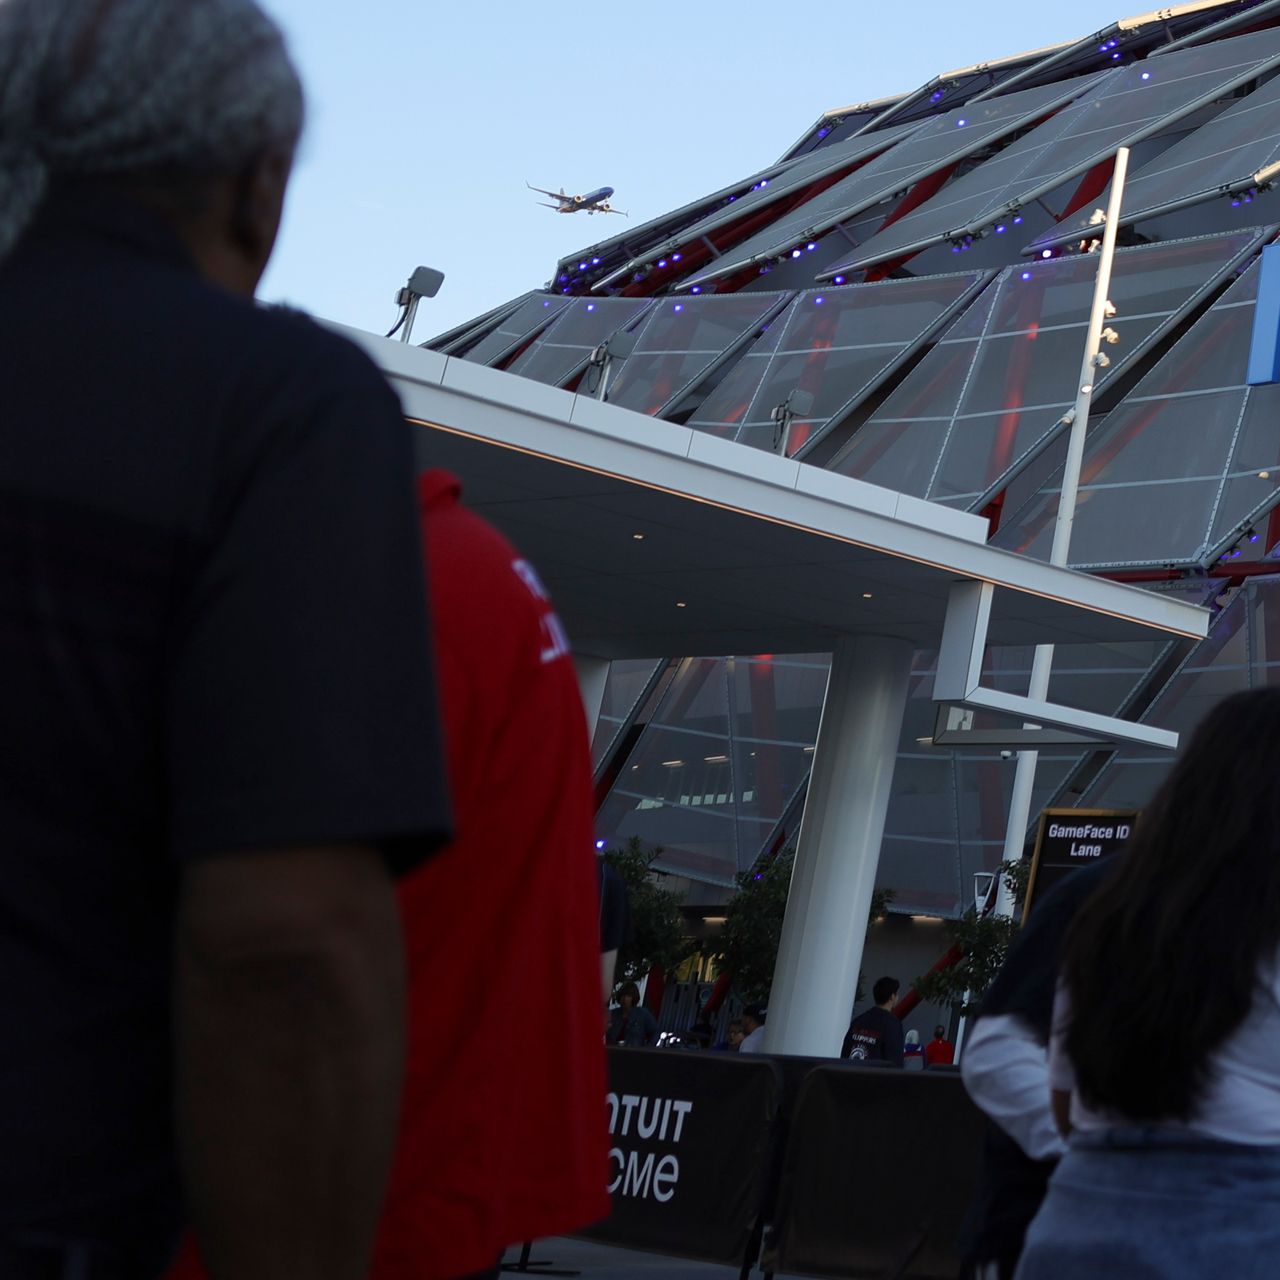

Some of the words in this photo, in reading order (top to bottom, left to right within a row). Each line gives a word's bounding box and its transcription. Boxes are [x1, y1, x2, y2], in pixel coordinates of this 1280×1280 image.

[1048, 823, 1113, 839] GameFace
[1115, 825, 1130, 839] ID
[1070, 841, 1102, 856] Lane
[605, 1091, 693, 1143] NTUIT
[605, 1147, 680, 1203] OME
